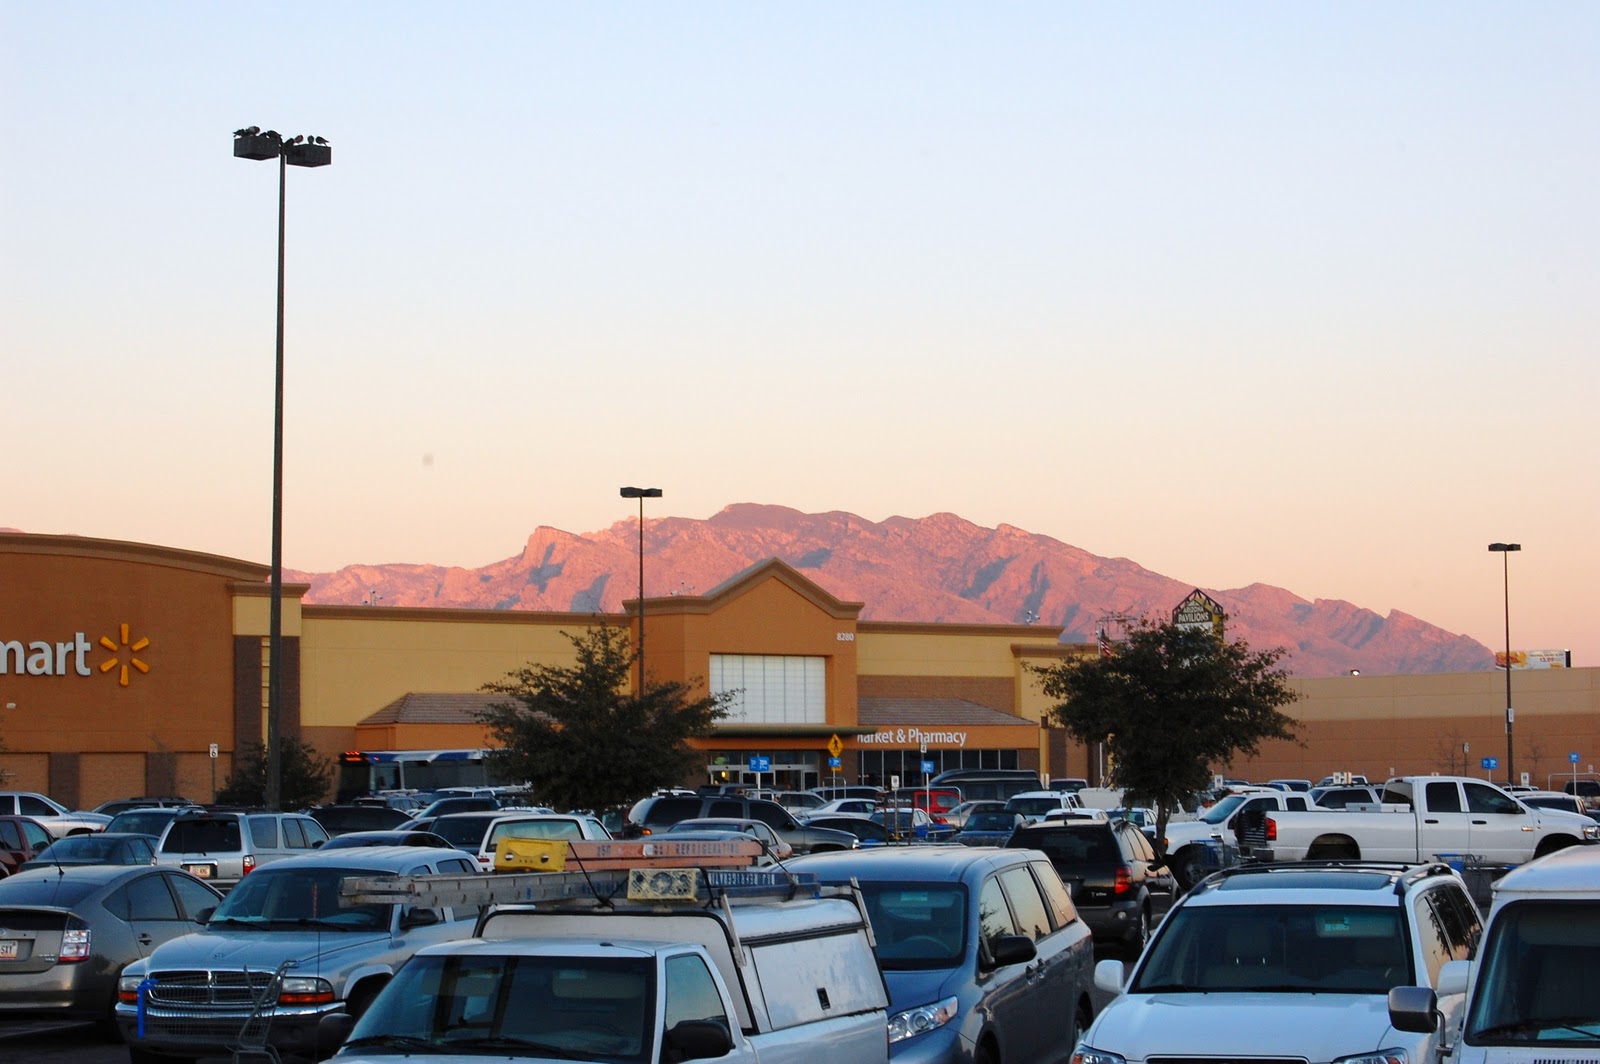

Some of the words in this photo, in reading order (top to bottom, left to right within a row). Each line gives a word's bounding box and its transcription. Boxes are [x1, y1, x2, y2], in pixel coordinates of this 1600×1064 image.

[1178, 612, 1209, 623] PAVILIONS
[836, 632, 854, 641] 8280
[896, 728, 906, 744] &
[908, 728, 967, 747] Pharmacy
